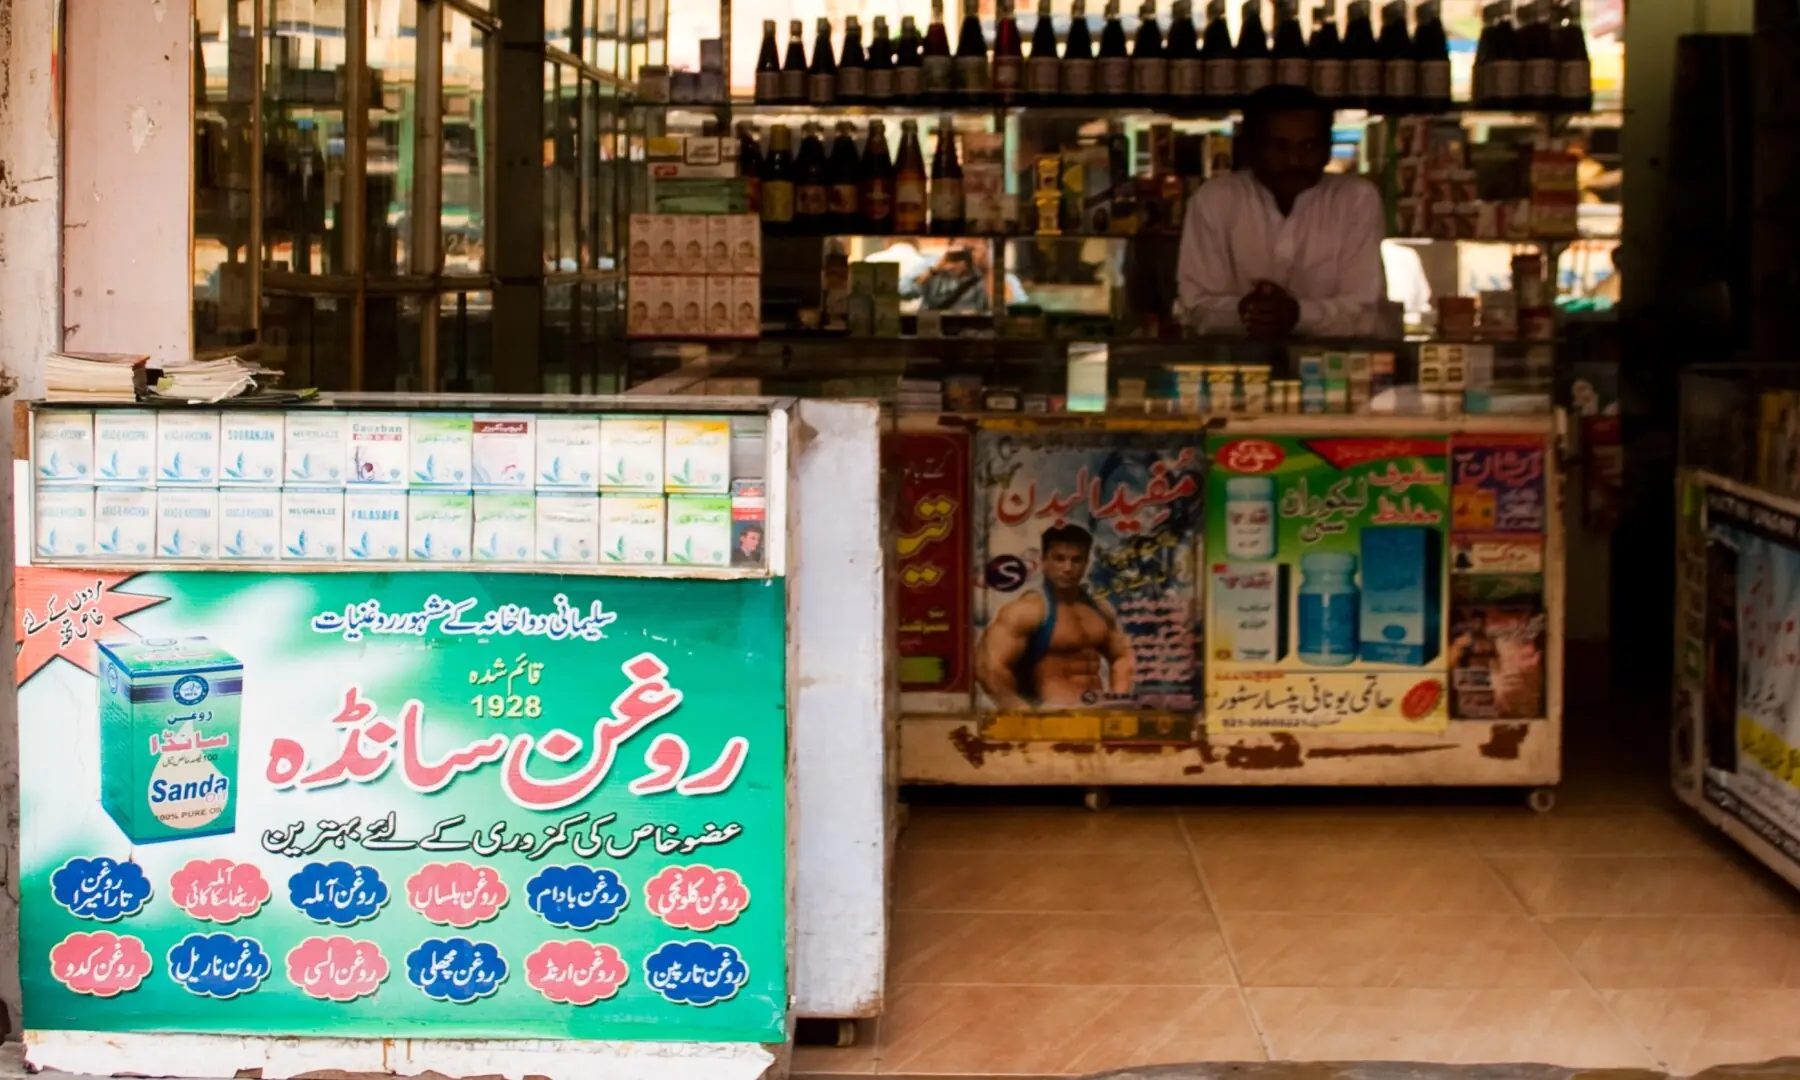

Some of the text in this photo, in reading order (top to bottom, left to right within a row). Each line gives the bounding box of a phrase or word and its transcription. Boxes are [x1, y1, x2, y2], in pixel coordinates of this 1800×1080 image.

[313, 599, 401, 640] روغنیات
[399, 595, 452, 635] مشہور
[441, 597, 477, 633] کے
[550, 594, 616, 639] سلیمانی
[468, 653, 545, 697] قائم شدہ
[167, 711, 213, 725] روغن
[471, 696, 541, 718] 1928
[150, 729, 230, 755] سانڈا
[265, 653, 749, 811] روغن سانڈہ
[151, 773, 228, 804] Sanda
[181, 809, 206, 819] PURE
[261, 816, 366, 857] بہترین
[420, 816, 473, 853] کے
[471, 813, 591, 860] کمزوری
[573, 814, 616, 857] کی
[81, 861, 123, 893] روغن
[207, 866, 236, 887] آملہ
[303, 870, 377, 908] روغن آملہ
[462, 871, 498, 907] روغن
[537, 875, 620, 911] روغن بادام
[658, 873, 739, 914] روغن کلونجی
[65, 943, 135, 980] روغن کدو
[177, 942, 263, 983] روغن ناریل
[304, 947, 377, 985] روغن السی
[420, 950, 496, 985] روغن مچھلی
[541, 951, 617, 986] روغن ارنڈ
[703, 952, 744, 988] روغن
